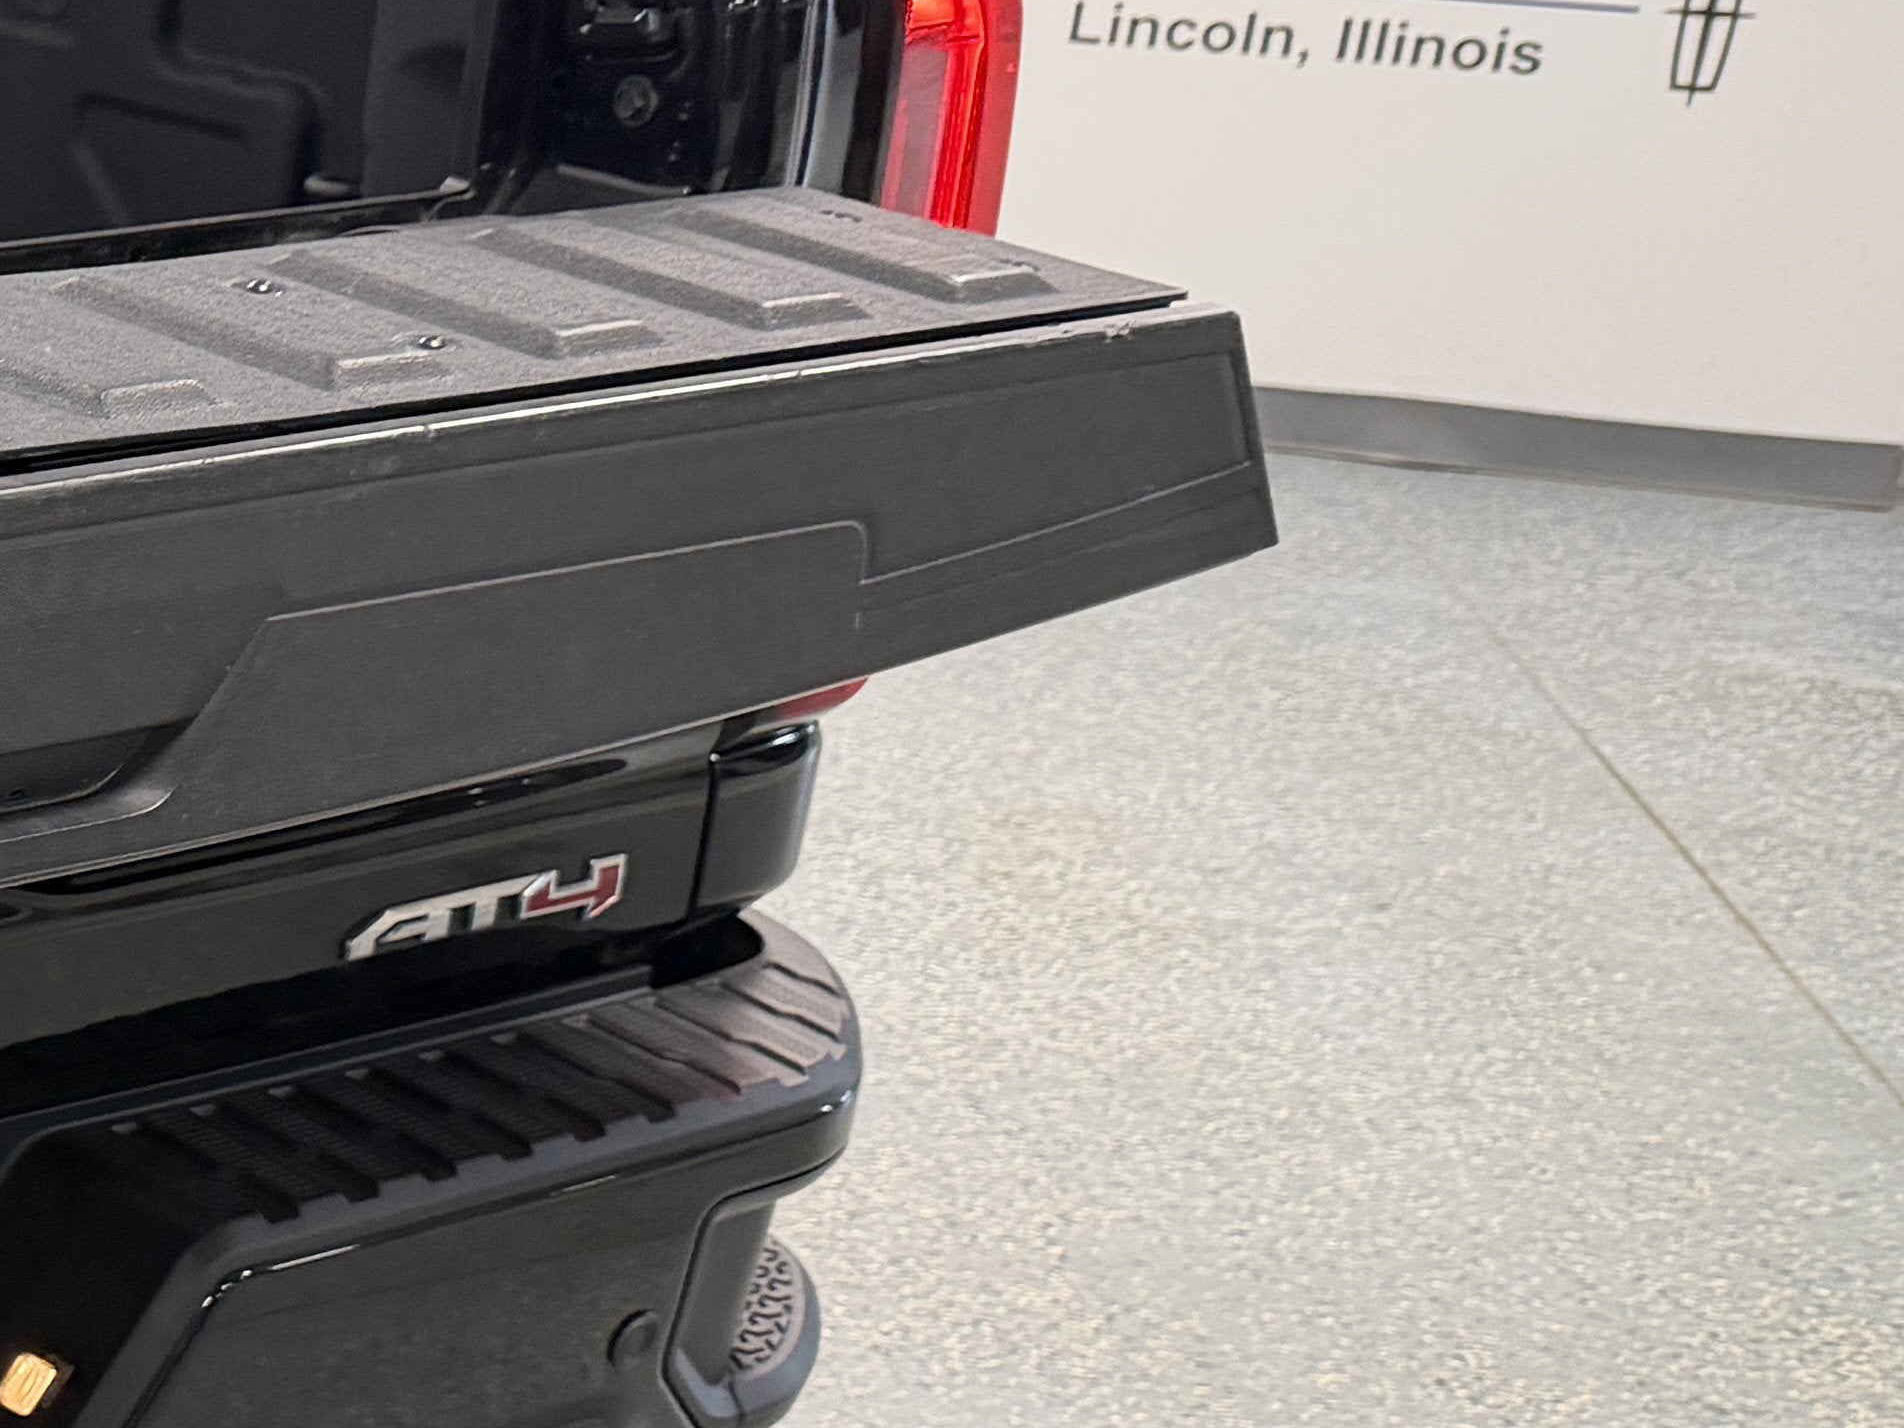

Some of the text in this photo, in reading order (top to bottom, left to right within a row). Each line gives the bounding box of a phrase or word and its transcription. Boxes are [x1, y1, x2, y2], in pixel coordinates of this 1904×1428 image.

[1067, 0, 1544, 76] Lincoln, Illinois
[344, 852, 629, 963] AT4
